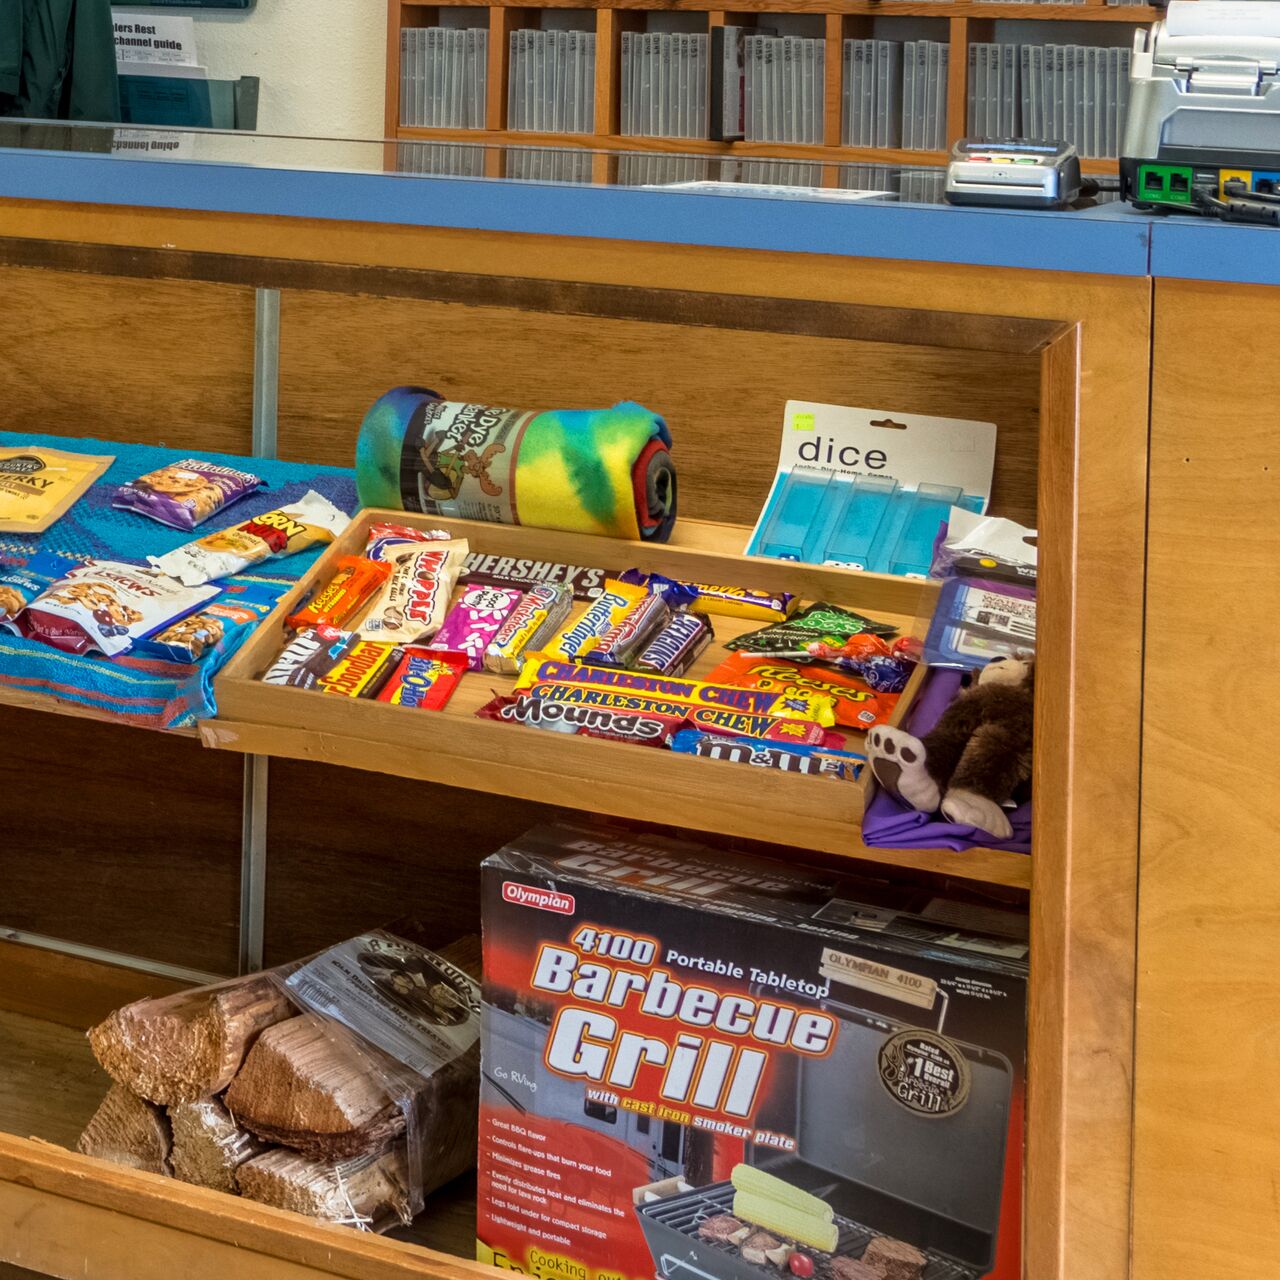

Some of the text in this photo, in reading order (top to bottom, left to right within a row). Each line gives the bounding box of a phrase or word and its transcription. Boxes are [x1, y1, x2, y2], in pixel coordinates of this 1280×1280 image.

[114, 36, 182, 51] channel guide
[135, 24, 156, 35] Rest
[798, 436, 888, 469] dice
[250, 509, 307, 539] CORN
[463, 552, 606, 588] HERSHEY'S
[494, 594, 543, 644] Musketeers
[560, 592, 629, 658] Butterfinger
[537, 661, 782, 715] CHARLESTON CHEW
[501, 695, 665, 739] Mounds
[530, 683, 780, 739] CHARLESTON CHEW
[556, 854, 730, 897] Grill
[506, 885, 570, 911] Olympian
[574, 927, 831, 1000] 4100 Portable Tabletop
[829, 952, 890, 979] OLYMPIAN
[896, 973, 923, 989] 4100
[531, 945, 835, 1055] Barbecue
[547, 1007, 768, 1118] Grill
[919, 1042, 940, 1055] Rated
[494, 1067, 509, 1081] Go
[896, 1071, 944, 1094] Barbecue
[924, 1058, 954, 1081] Best
[897, 1082, 941, 1112] Grill
[492, 1118, 547, 1142] Great BBQ flavor
[587, 1088, 795, 1150] with cast iron smoker plate
[492, 1135, 612, 1177] Controls burn food
[492, 1151, 561, 1181] Minimizes grease fires
[491, 1180, 507, 1192] need
[491, 1171, 612, 1214] Evenly distributes eliminates
[491, 1213, 572, 1247] Lightweight portable
[551, 1217, 580, 1233] compact
[530, 1249, 587, 1280] Cooking
